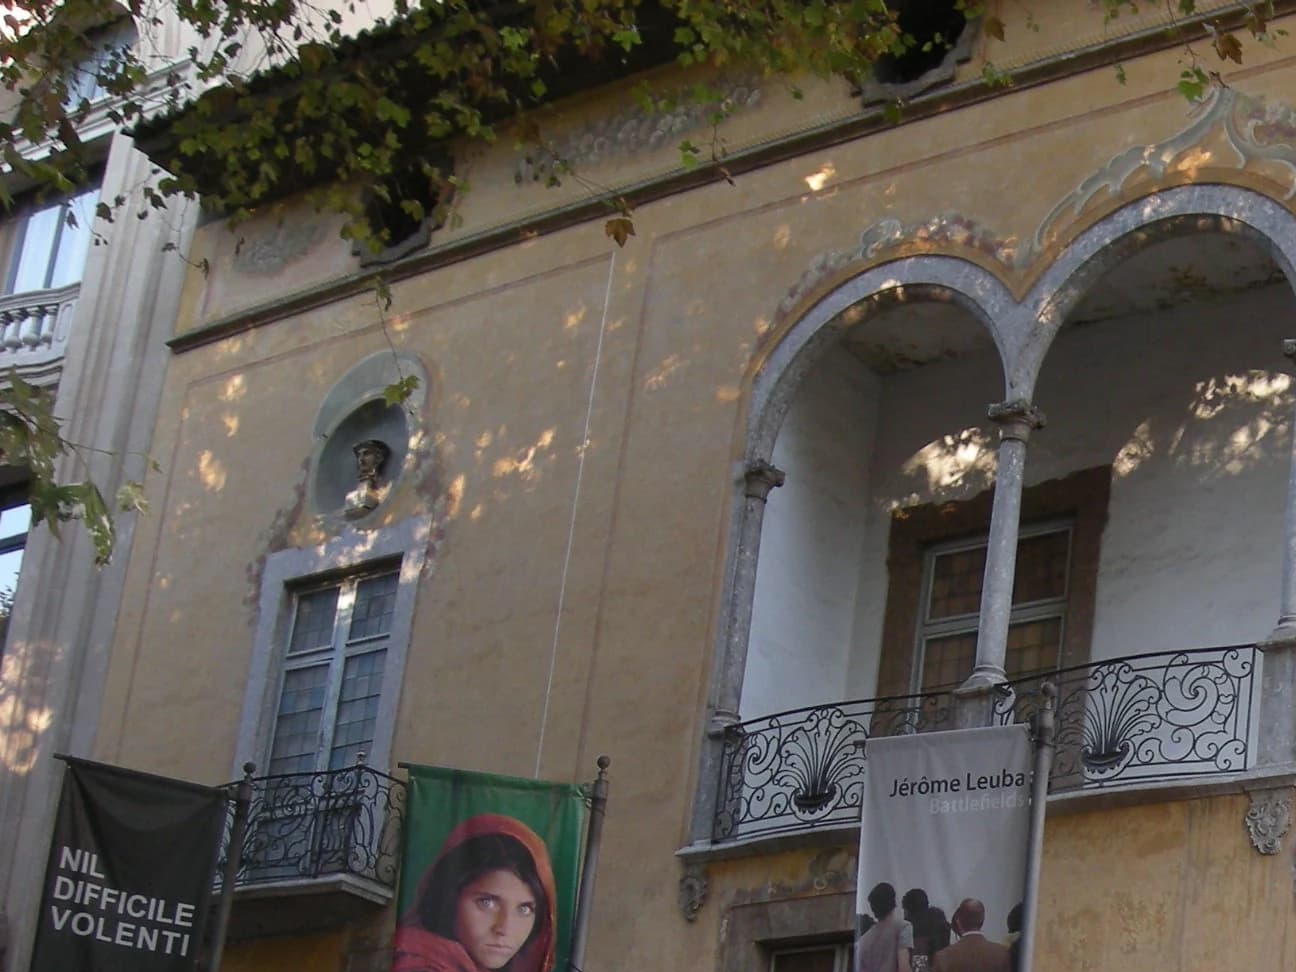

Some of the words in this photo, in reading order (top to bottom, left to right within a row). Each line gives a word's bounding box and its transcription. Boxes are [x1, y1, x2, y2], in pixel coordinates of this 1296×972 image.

[889, 775, 961, 797] Jérôme
[966, 768, 1025, 791] Leuba
[59, 845, 105, 879] NIL
[53, 875, 196, 927] DIFFICILE
[51, 905, 191, 957] VOLENTI
